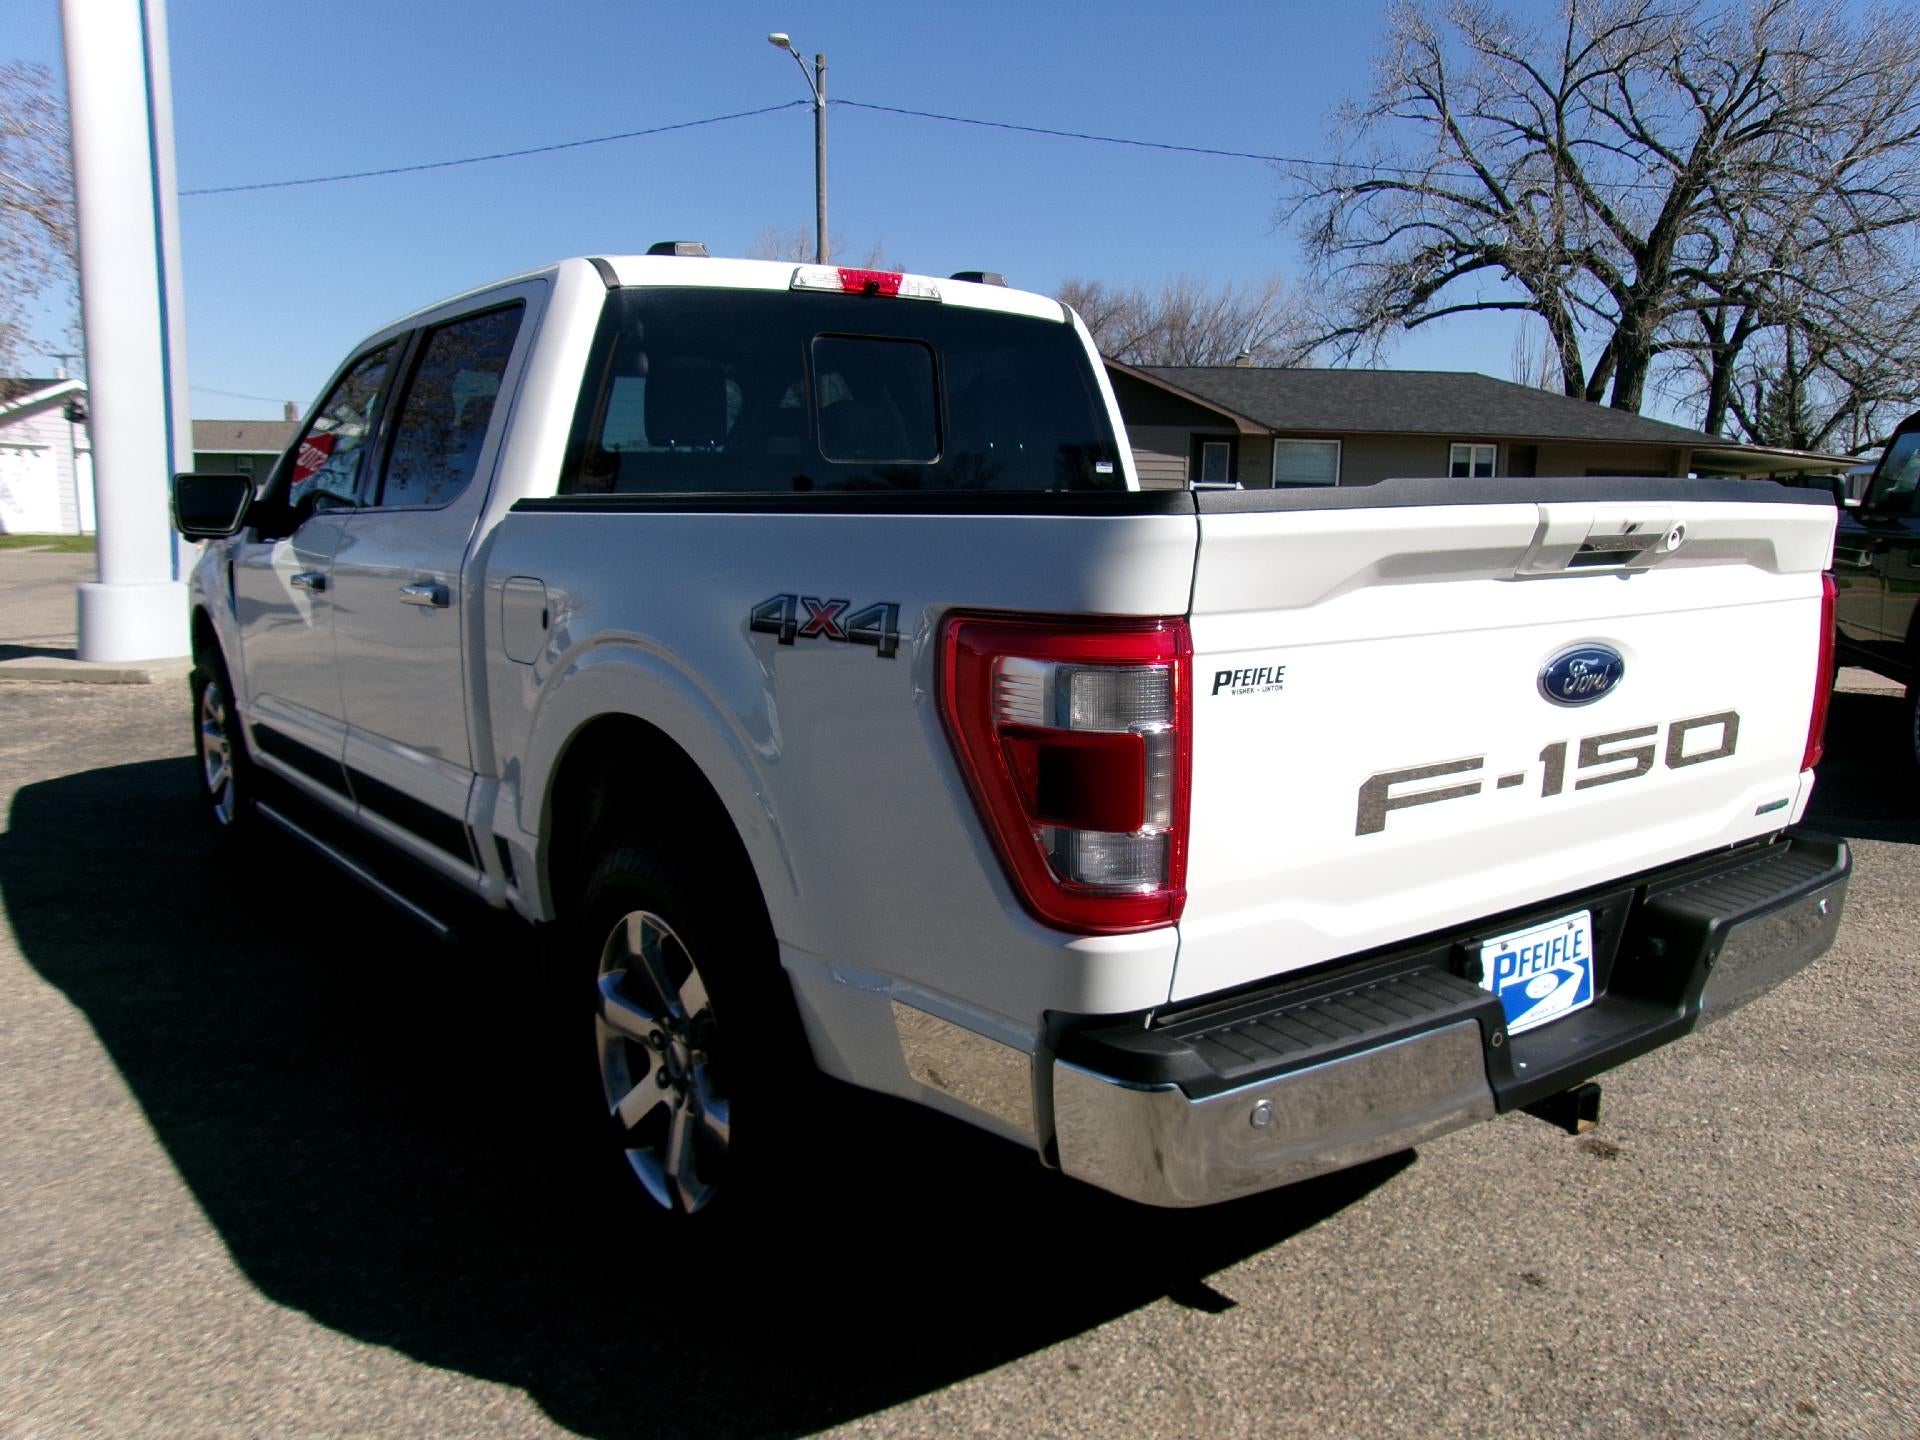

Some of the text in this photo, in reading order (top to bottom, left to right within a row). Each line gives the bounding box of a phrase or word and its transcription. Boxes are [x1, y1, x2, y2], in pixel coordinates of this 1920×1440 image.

[1211, 665, 1286, 696] PFEIFLE
[1563, 658, 1610, 695] Ford
[1354, 708, 1741, 837] F-150
[1492, 929, 1584, 993] PFEIFLE
